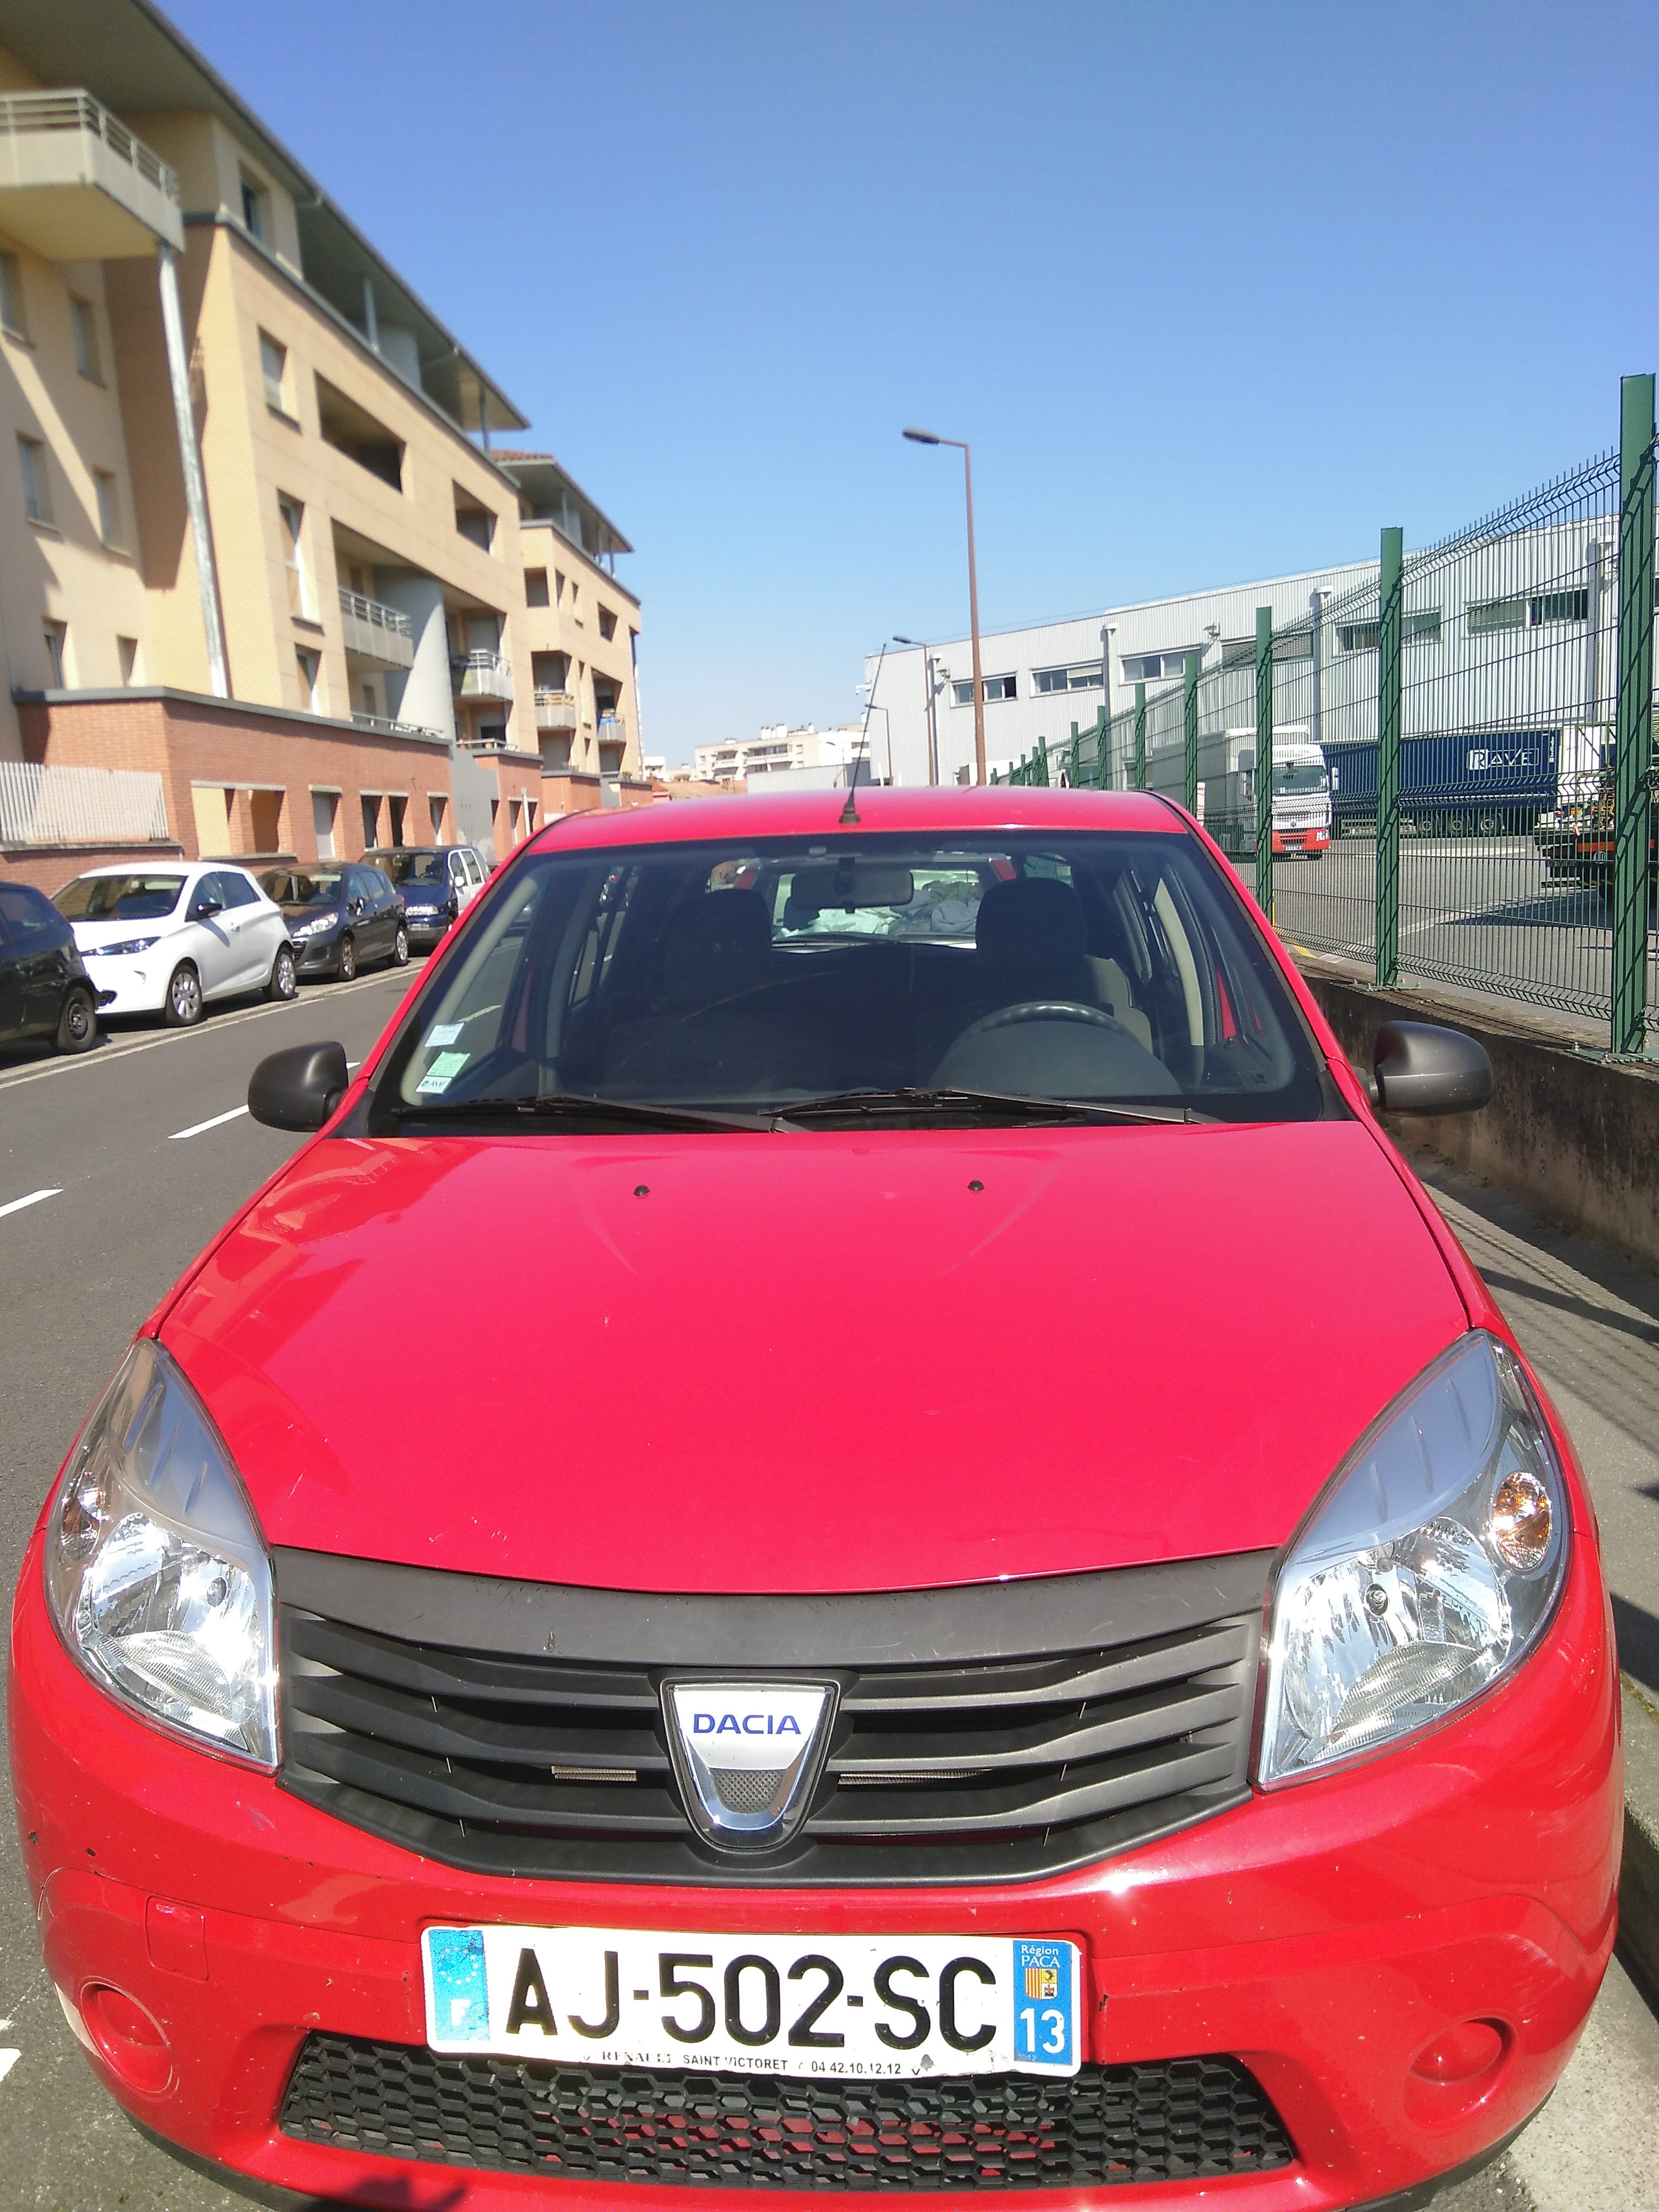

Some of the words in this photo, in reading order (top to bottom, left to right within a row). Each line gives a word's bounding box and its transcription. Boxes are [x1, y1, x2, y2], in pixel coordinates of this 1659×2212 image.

[693, 1714, 801, 1735] DACIA
[1021, 1945, 1058, 1957] Région
[1021, 1955, 1060, 1968] PACA
[505, 1947, 997, 2052] AJ-502-SC
[450, 1999, 471, 2027] F
[1020, 2008, 1065, 2054] 13
[683, 2054, 720, 2066] SAINT
[725, 2057, 788, 2071] VICTORET
[811, 2061, 826, 2073] 04
